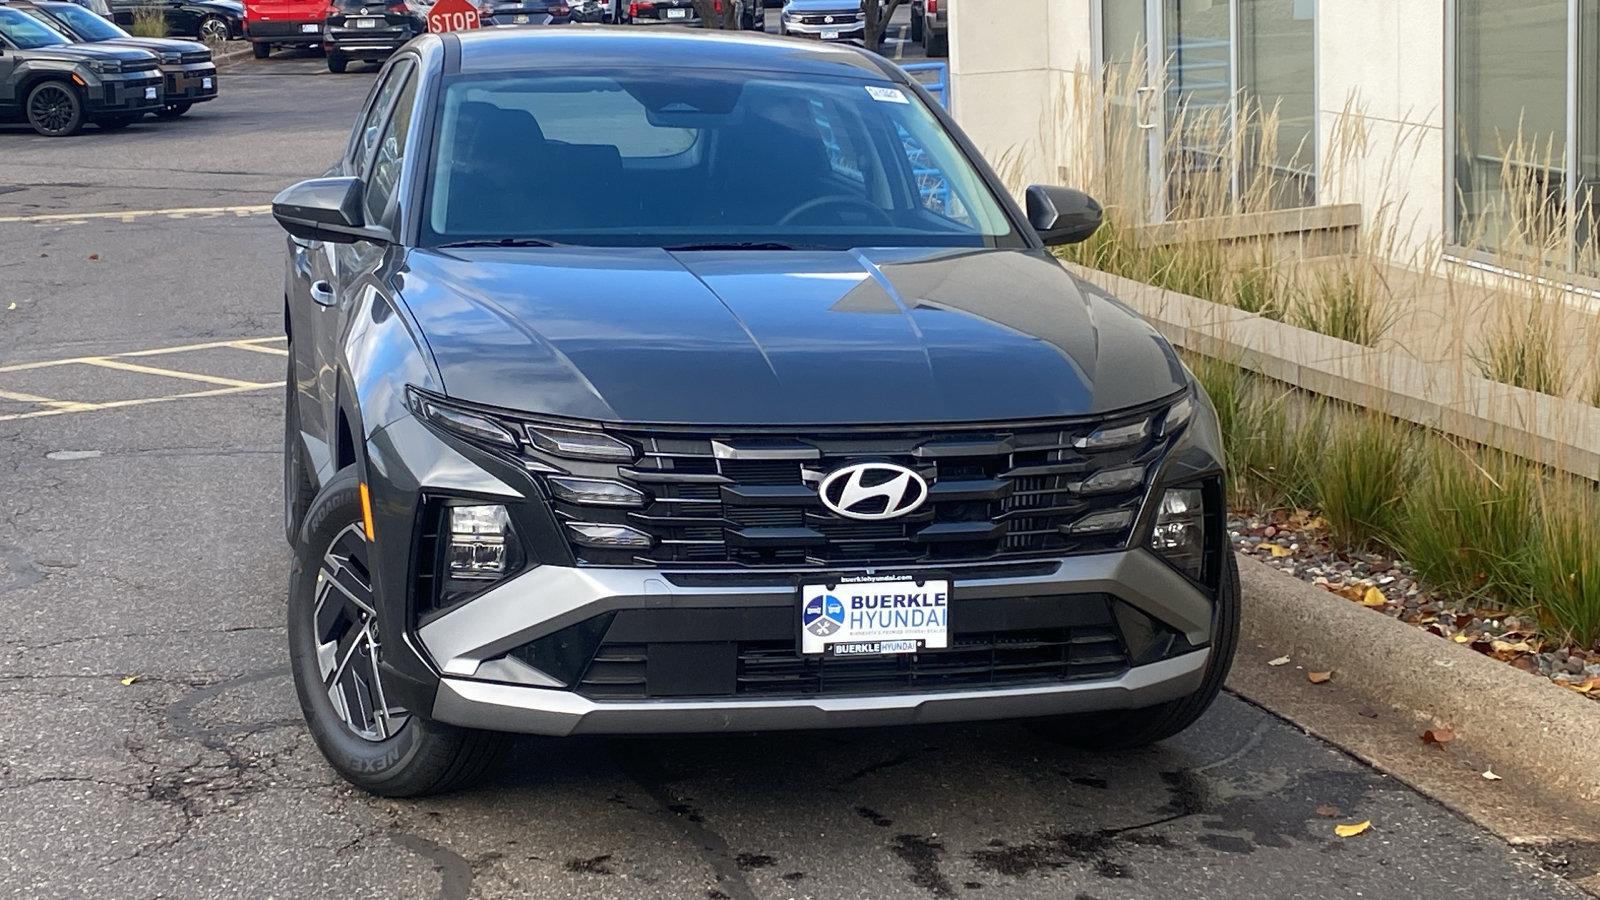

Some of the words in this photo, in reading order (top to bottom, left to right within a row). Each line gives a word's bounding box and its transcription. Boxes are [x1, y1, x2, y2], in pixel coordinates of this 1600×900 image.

[431, 11, 476, 33] STOP
[851, 593, 946, 609] BUERKLE
[850, 608, 946, 629] HYUNDAI
[835, 643, 880, 654] BUERKLE
[881, 640, 915, 651] HYUNDAI
